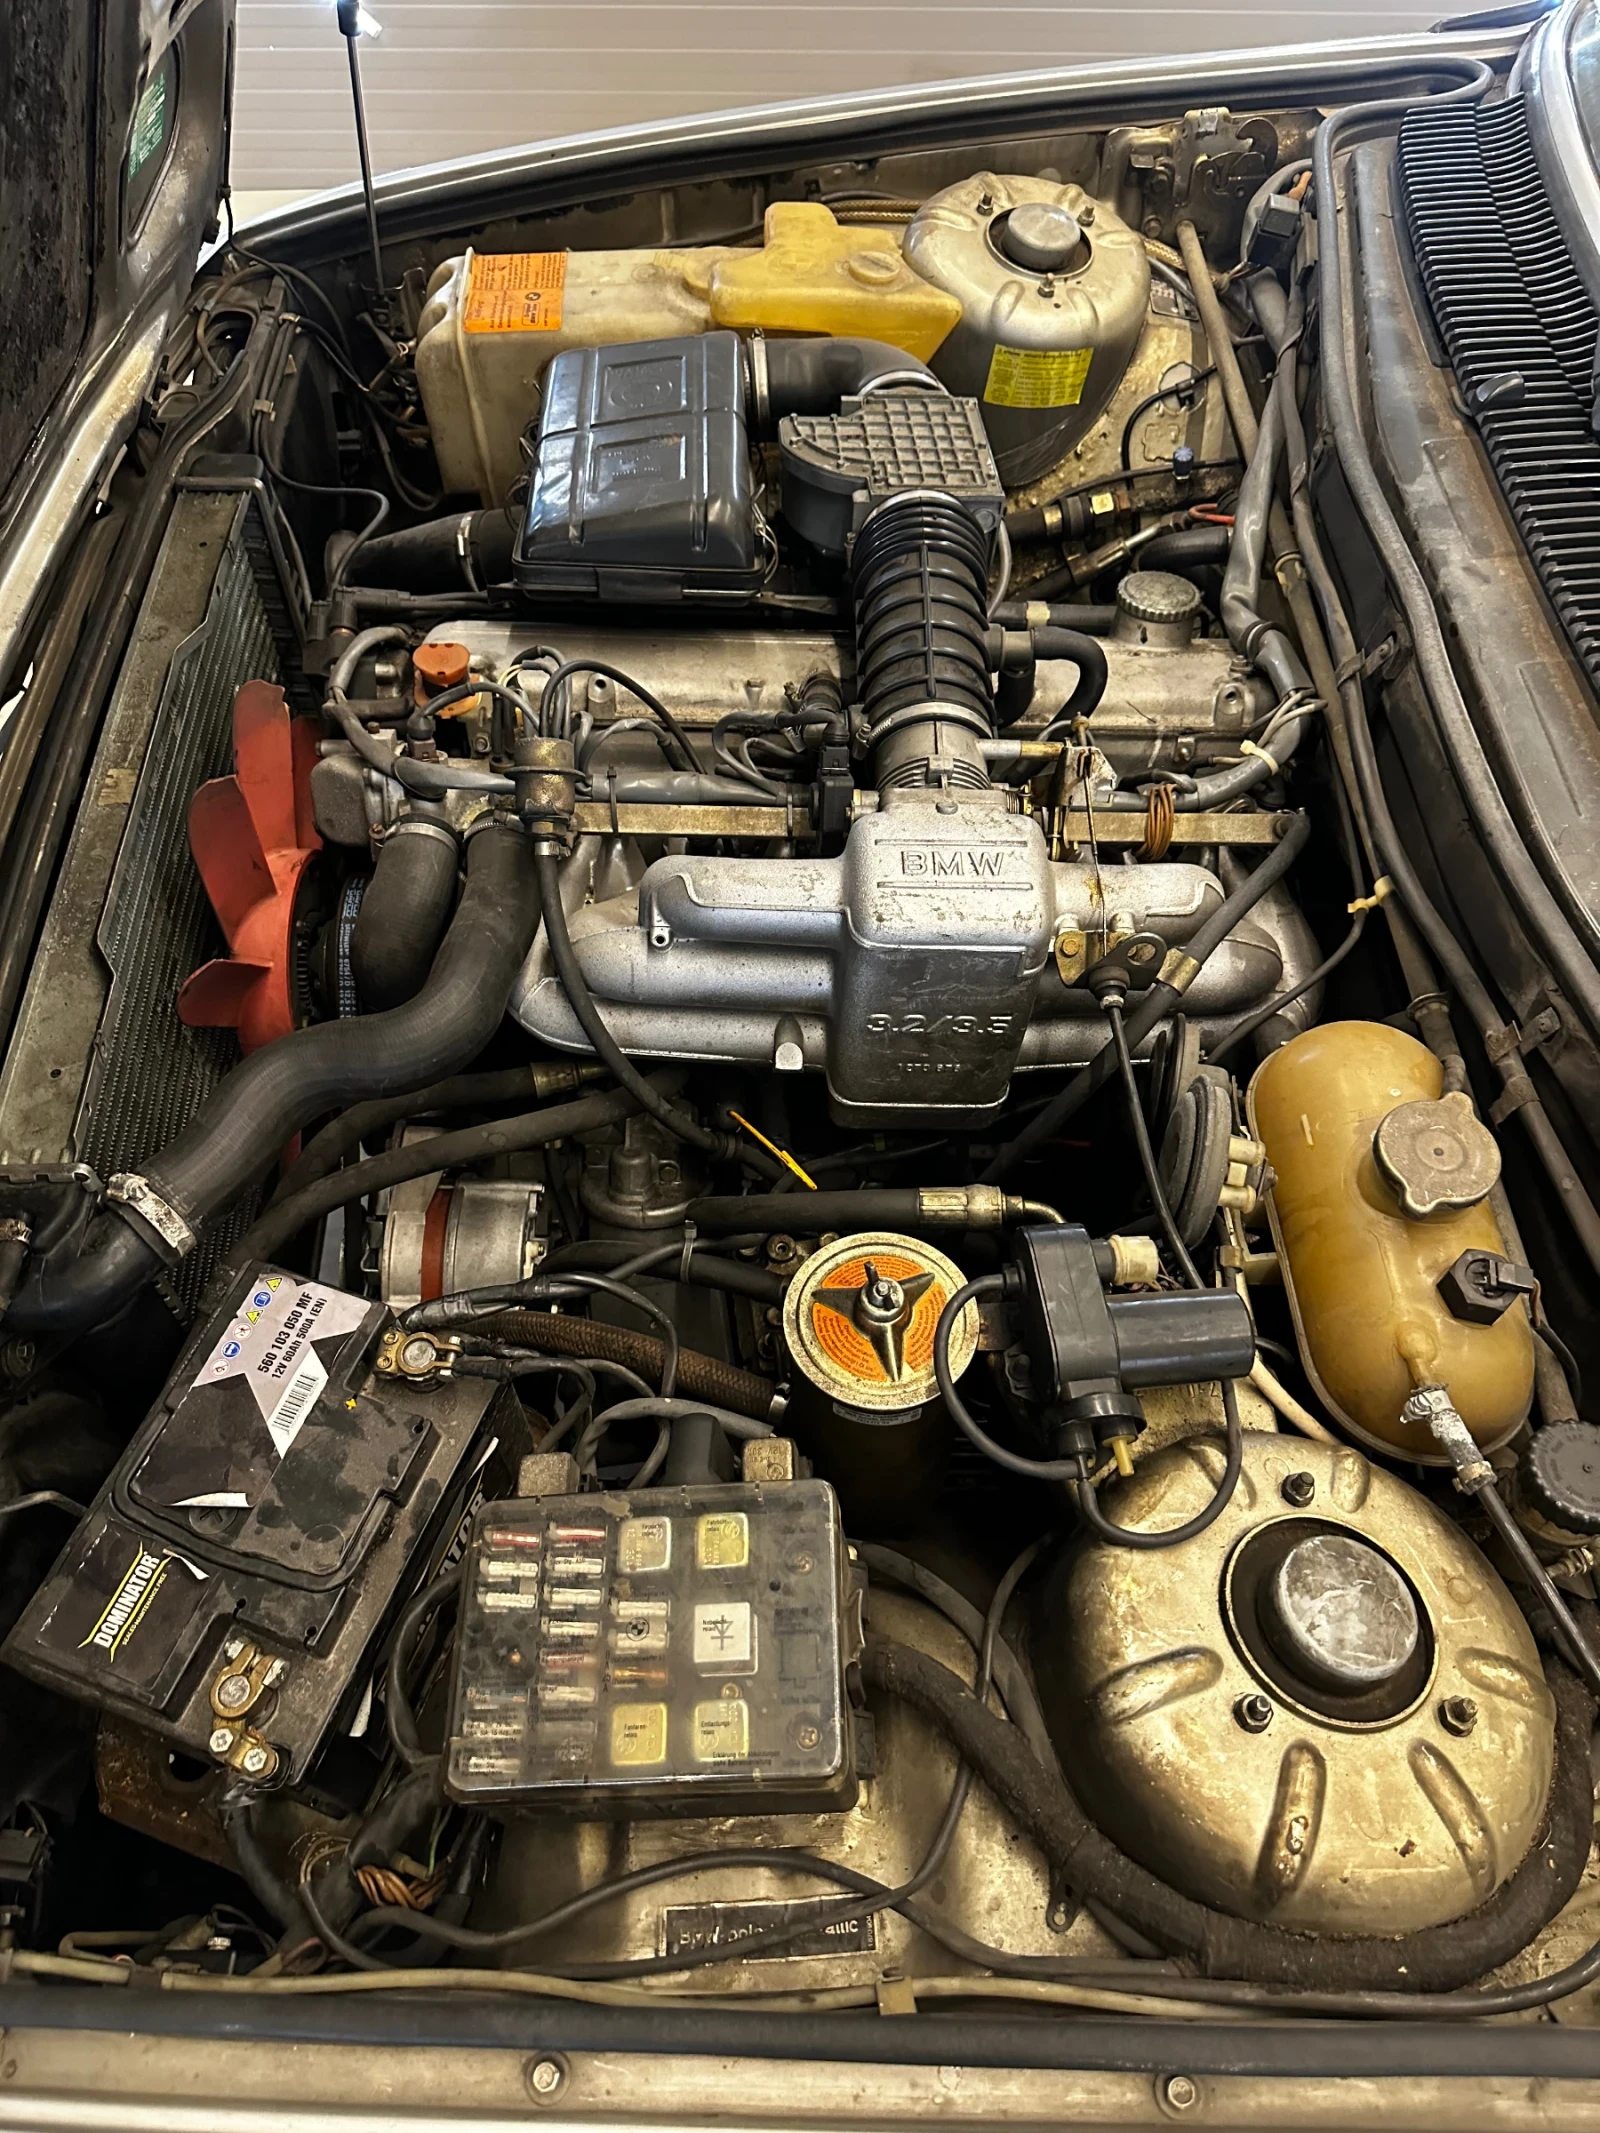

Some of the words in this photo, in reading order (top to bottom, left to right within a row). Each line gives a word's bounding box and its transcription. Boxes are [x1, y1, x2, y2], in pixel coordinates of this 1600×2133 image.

[900, 850, 1004, 876] BMW
[867, 1013, 1013, 1034] 3.2/3.5
[257, 1353, 278, 1374] 560
[271, 1331, 291, 1350] 103
[284, 1311, 304, 1331] 050
[296, 1291, 314, 1312] MF
[271, 1361, 288, 1380] 12V
[285, 1341, 303, 1363] 60Ah
[297, 1318, 315, 1340] 500A
[310, 1297, 328, 1317] (EN)
[93, 1553, 160, 1649] DOMINATOR
[155, 1572, 168, 1588] FREE
